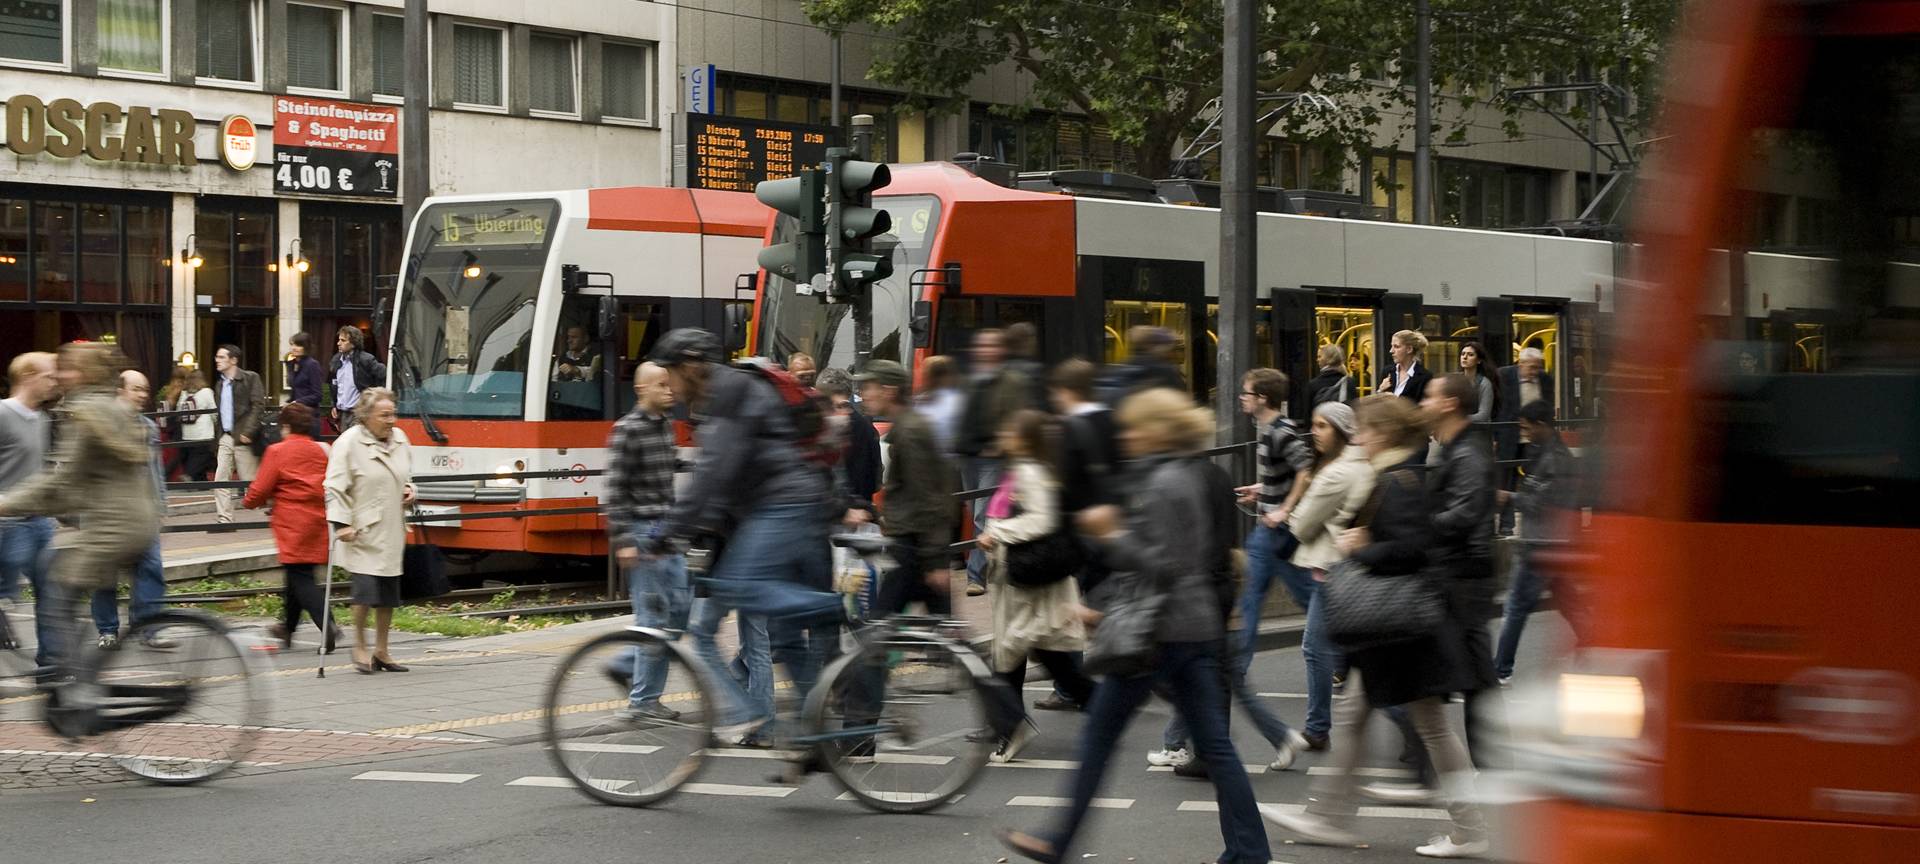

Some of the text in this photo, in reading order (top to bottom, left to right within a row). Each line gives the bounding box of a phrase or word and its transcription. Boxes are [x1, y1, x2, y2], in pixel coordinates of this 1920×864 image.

[277, 99, 395, 123] Steinofenpizza
[6, 94, 198, 166] OSCAR
[288, 120, 386, 141] & Spaghetti
[706, 124, 740, 137] Dienstag
[231, 138, 250, 150] früh
[697, 134, 706, 144] 15
[767, 140, 787, 151] Gleis
[277, 152, 308, 163] für nur
[697, 145, 706, 155] 15
[767, 151, 787, 161] Gleis
[697, 167, 706, 177] 15
[767, 161, 787, 172] Gleis
[276, 163, 354, 191] 4,00 €
[443, 212, 460, 242] 15
